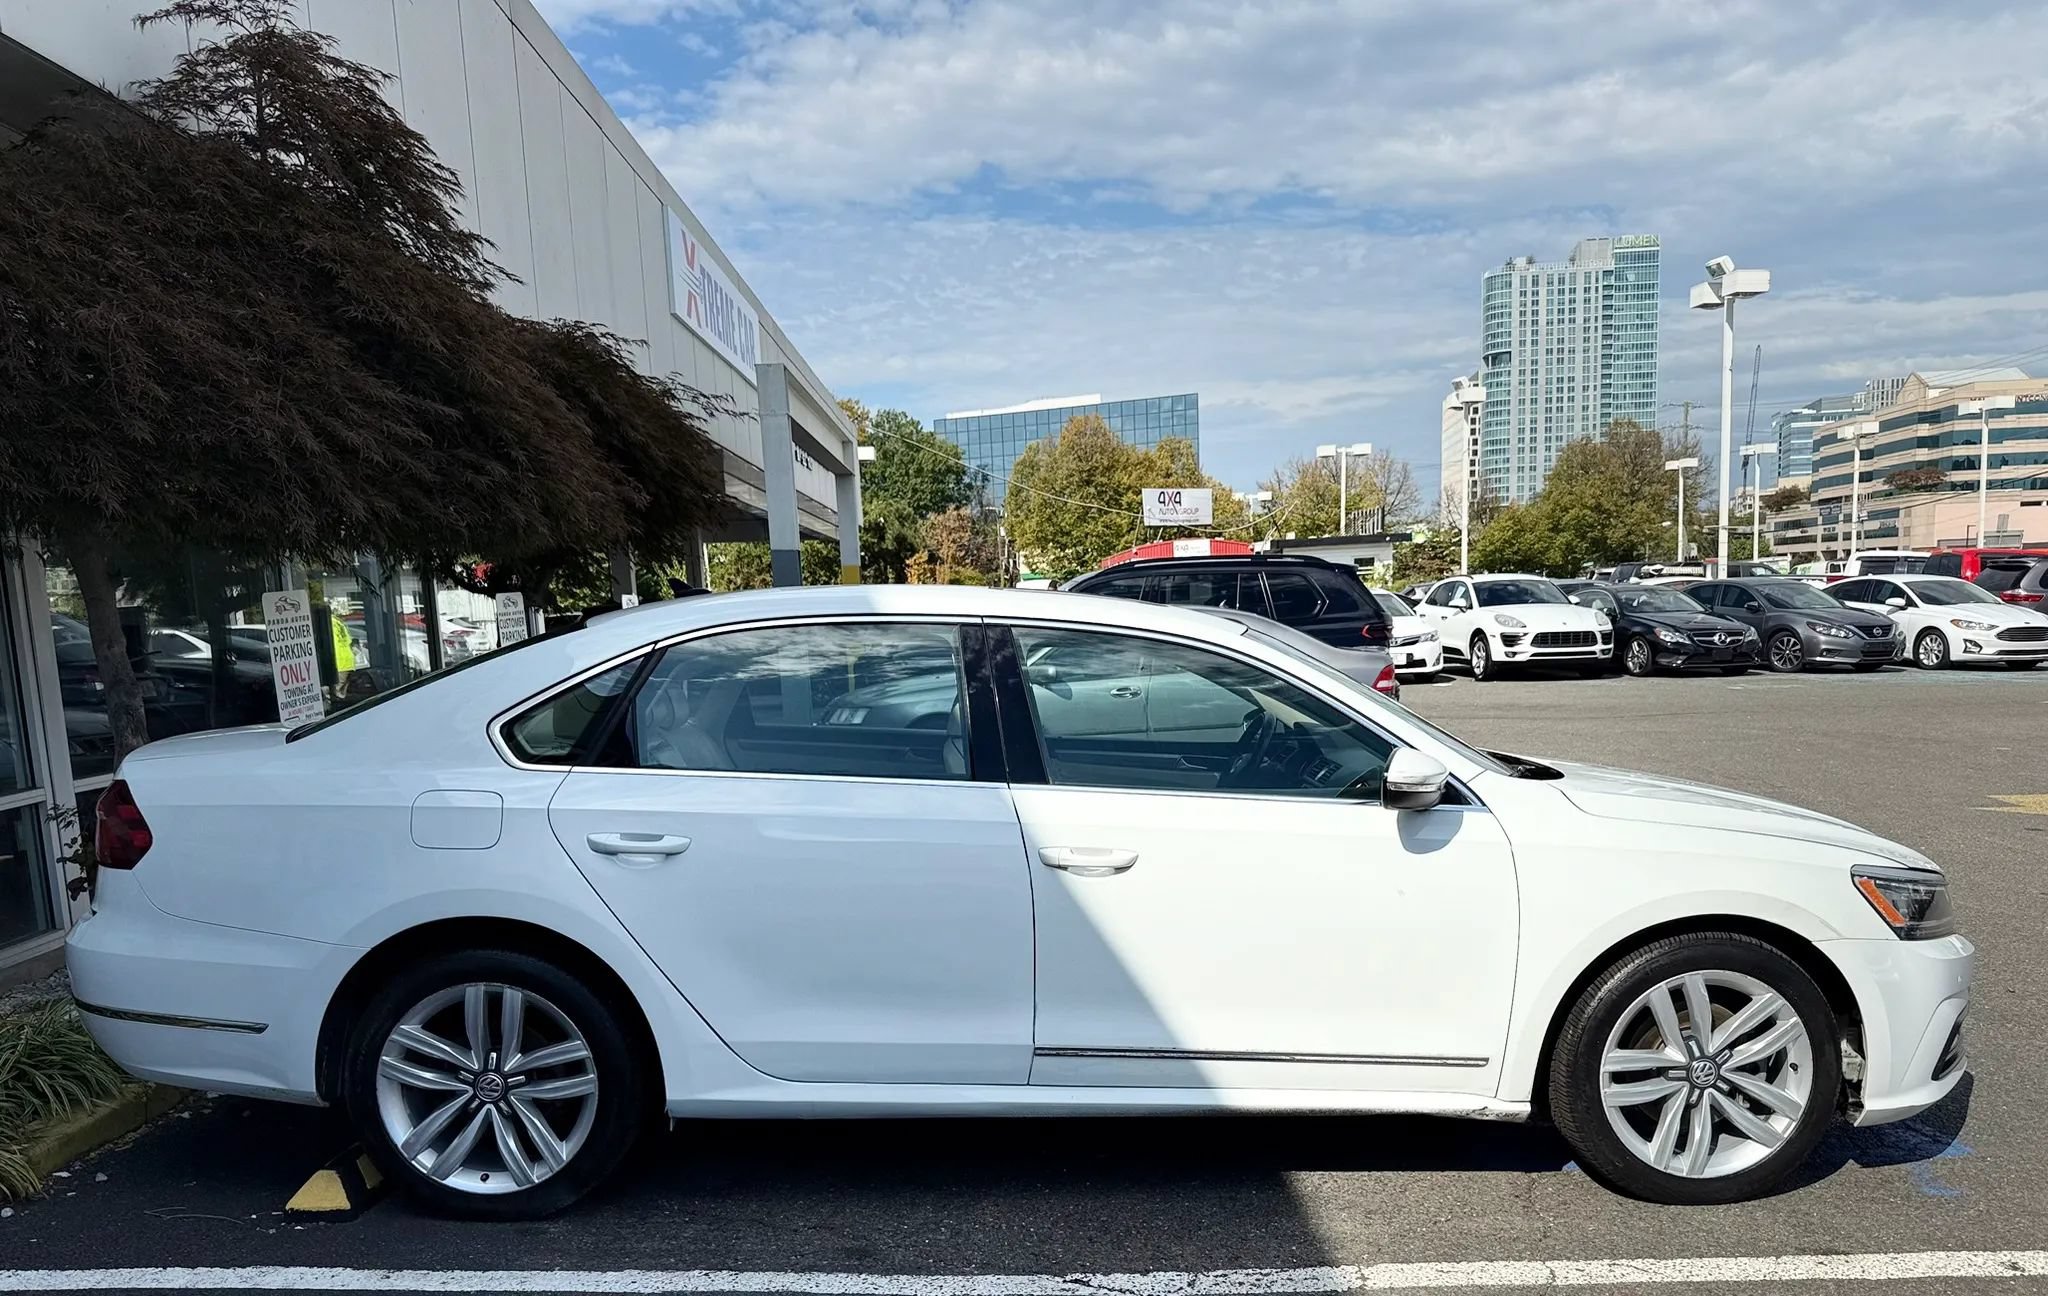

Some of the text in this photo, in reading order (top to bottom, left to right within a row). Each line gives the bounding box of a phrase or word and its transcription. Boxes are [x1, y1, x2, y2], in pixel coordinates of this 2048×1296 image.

[1615, 234, 1659, 247] LUMEN
[1159, 507, 1199, 515] AUTO GROUP
[499, 616, 525, 629] CUSTOMER
[268, 624, 311, 643] CUSTOMER
[502, 629, 526, 643] PARKING
[274, 641, 313, 662] PARKING
[280, 660, 311, 686] ONLY
[284, 684, 314, 700] TOWING AT
[280, 693, 320, 711] OWNER'S EXPENSE
